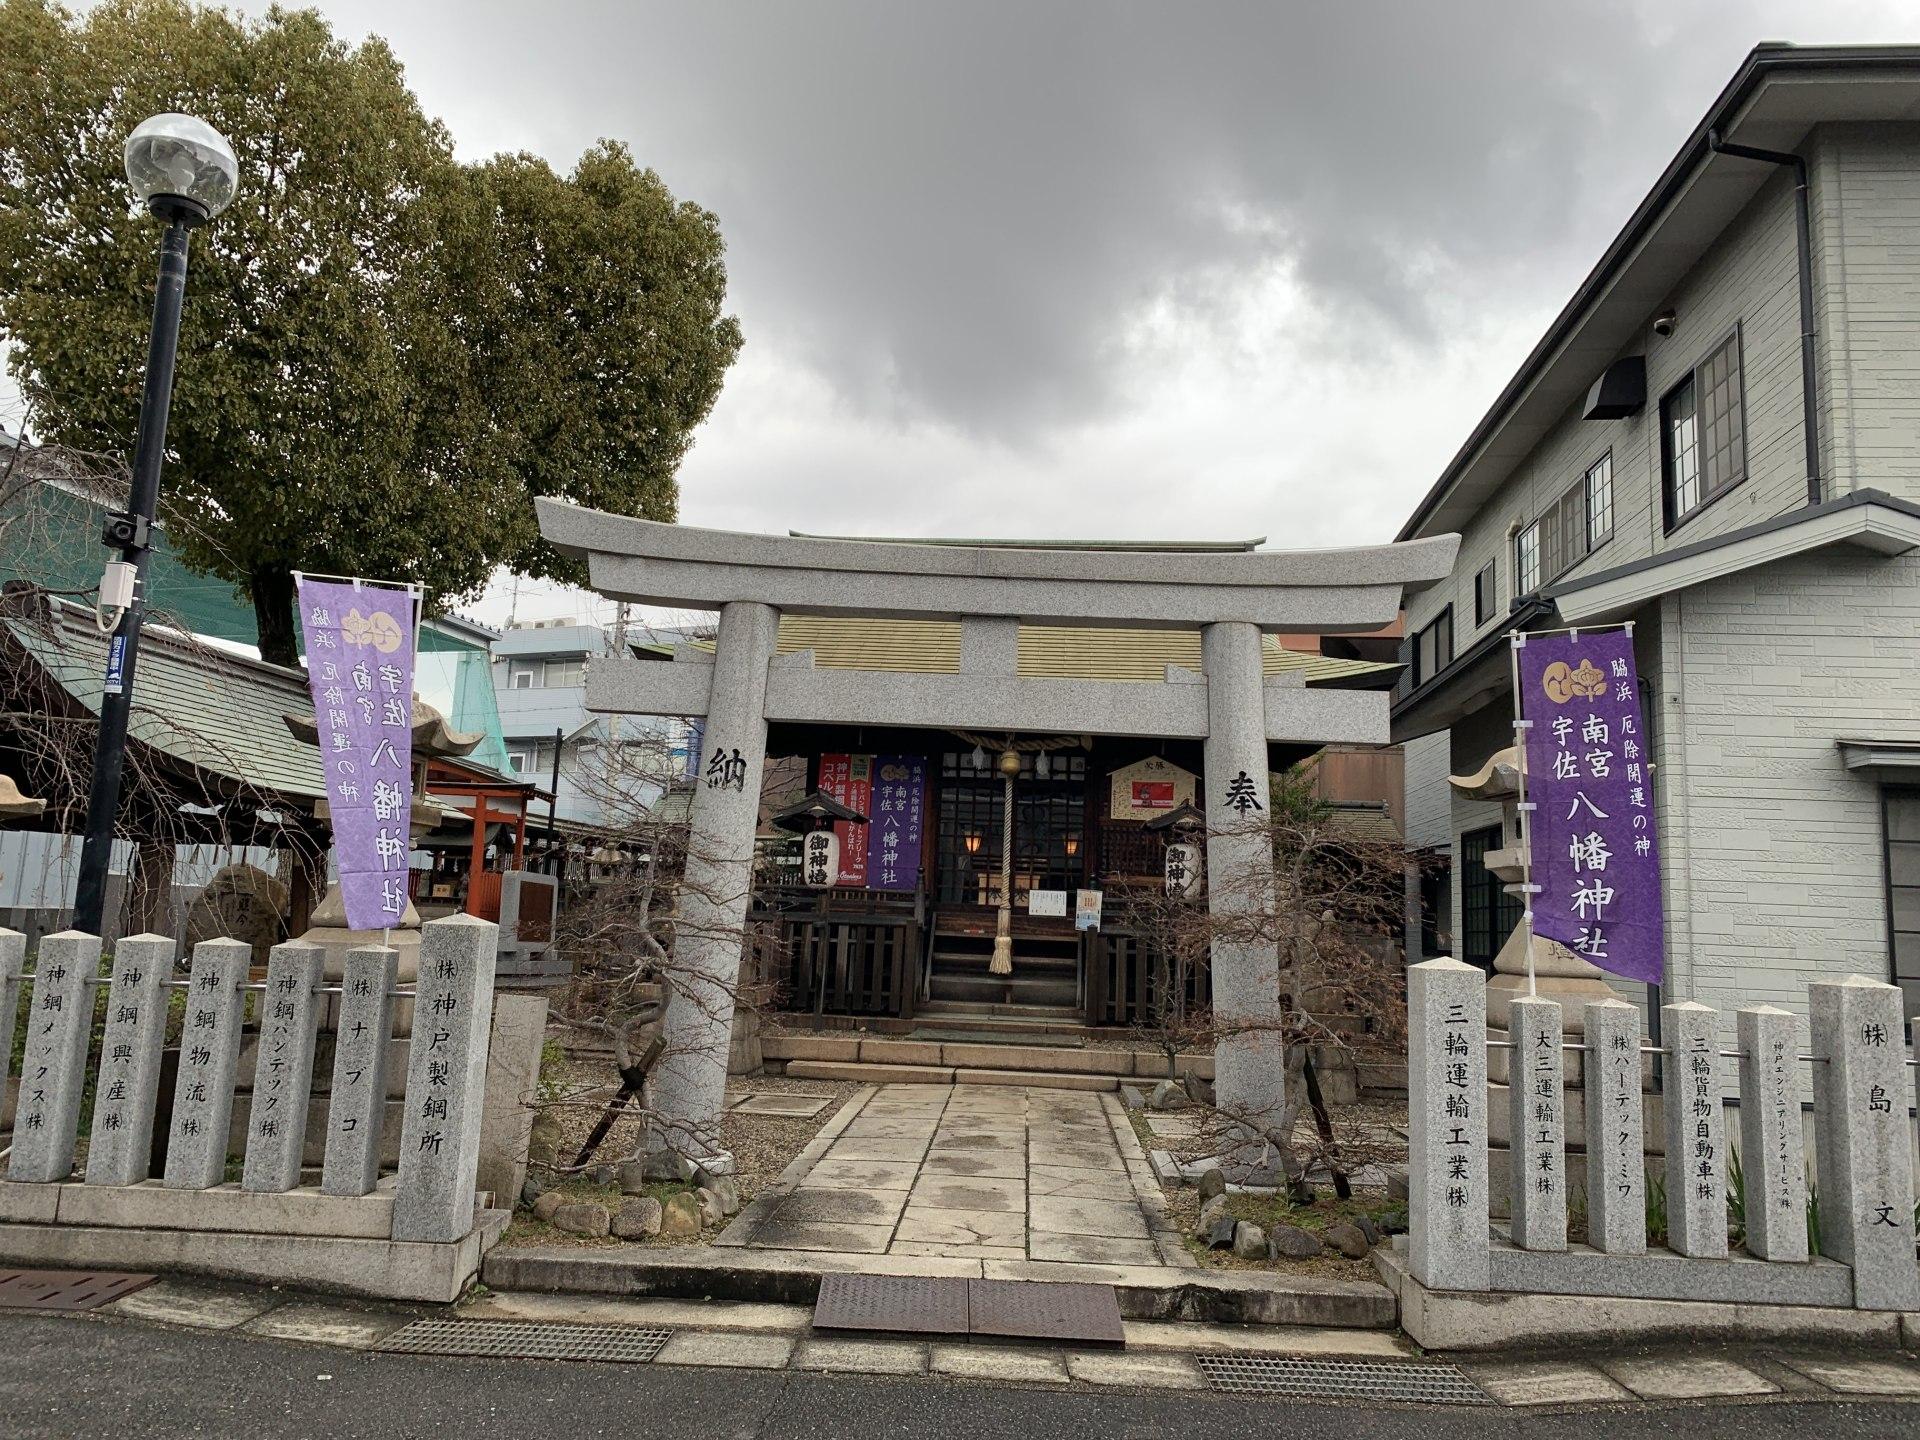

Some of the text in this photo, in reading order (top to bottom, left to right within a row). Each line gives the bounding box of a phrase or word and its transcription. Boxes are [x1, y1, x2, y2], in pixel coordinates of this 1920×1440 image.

[706, 746, 748, 793] 納
[823, 763, 834, 792] コベル
[1551, 714, 1581, 780] 宇佐
[1581, 713, 1613, 779] 南宮
[1611, 657, 1651, 858] 脇浜 厄除開運の神
[1223, 770, 1263, 817] 奉
[881, 815, 900, 885] 八幡神社
[1566, 790, 1615, 958] 八幡神社
